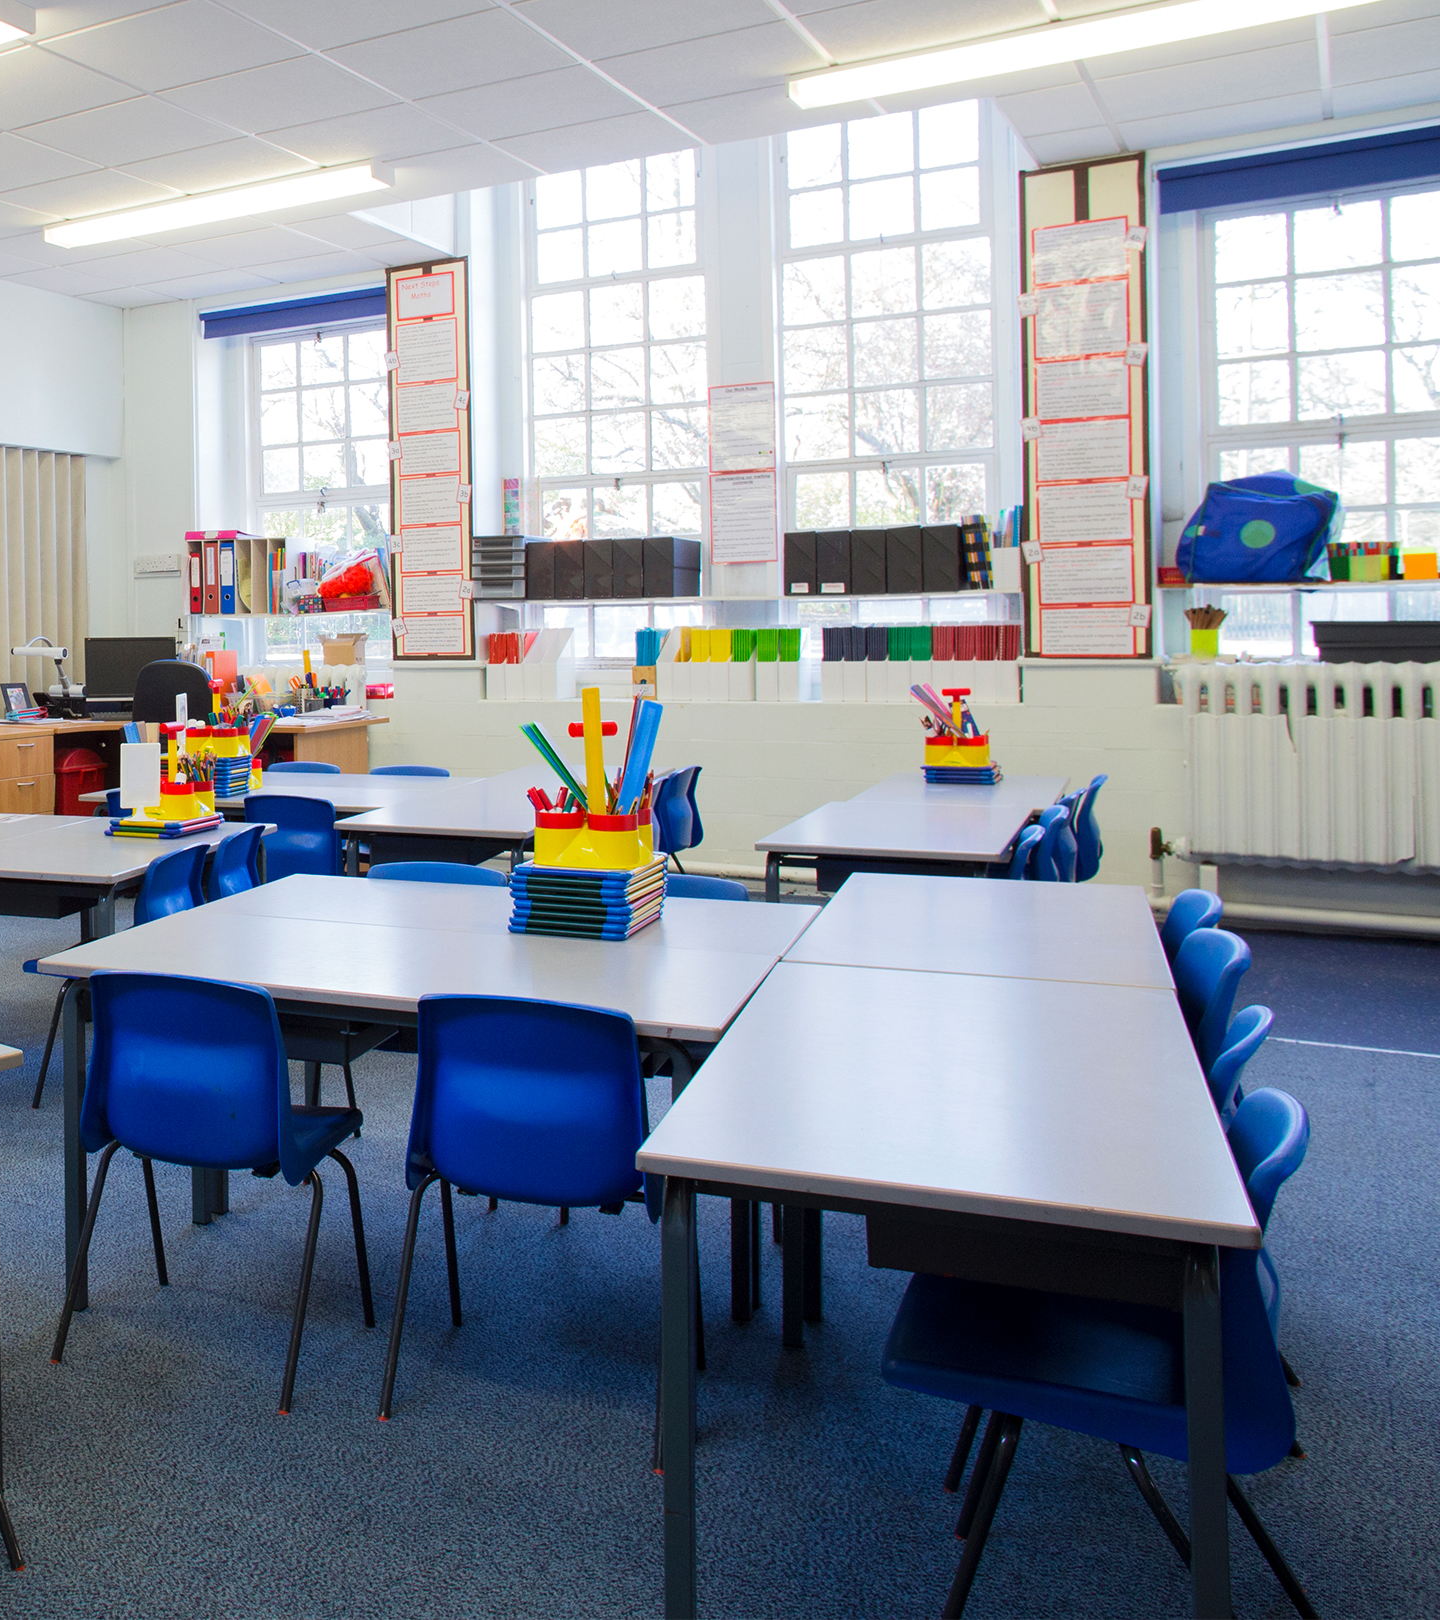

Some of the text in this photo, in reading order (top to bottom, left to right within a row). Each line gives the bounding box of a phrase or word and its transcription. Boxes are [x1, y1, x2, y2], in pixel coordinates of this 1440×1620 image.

[401, 280, 440, 291] Next Steps
[410, 291, 432, 300] Maths
[1130, 351, 1141, 359] 3a
[388, 357, 397, 365] 4b
[458, 396, 466, 404] 4c
[1131, 484, 1142, 492] 3c
[460, 489, 469, 497] 3b
[1027, 549, 1039, 557] 2a
[462, 586, 471, 594] 2a
[1133, 611, 1145, 620] 2b
[395, 624, 404, 632] 2b
